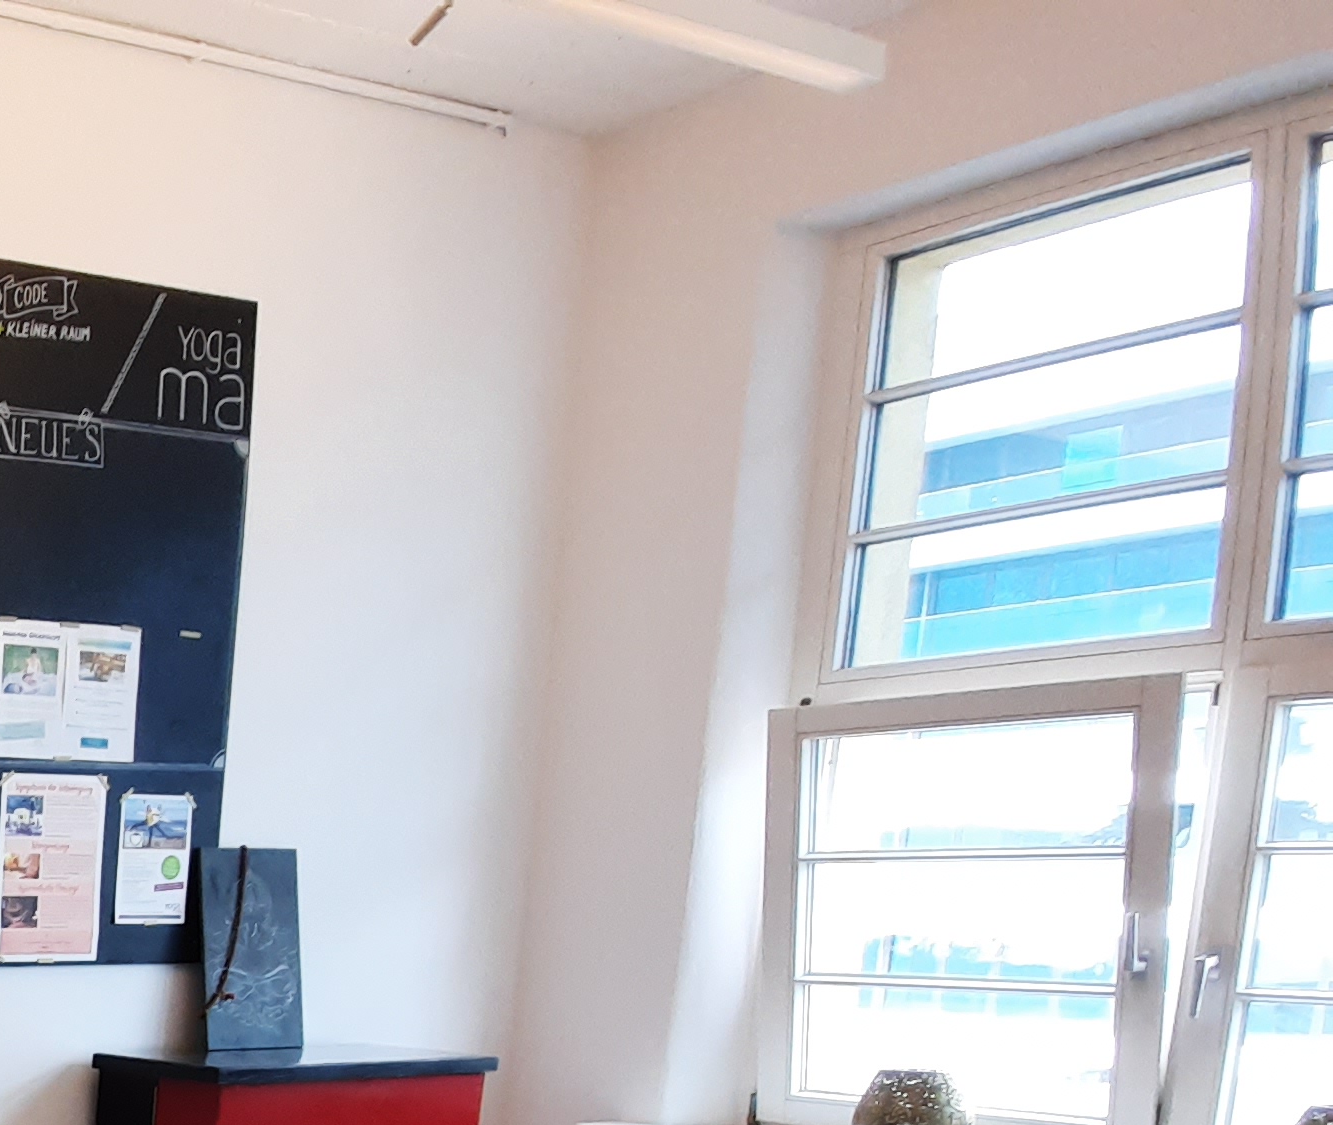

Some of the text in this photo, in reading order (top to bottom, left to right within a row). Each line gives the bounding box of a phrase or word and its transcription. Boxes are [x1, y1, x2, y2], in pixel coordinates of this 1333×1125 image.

[14, 282, 49, 308] CODE
[60, 325, 91, 342] RAUM
[157, 366, 245, 431] ma
